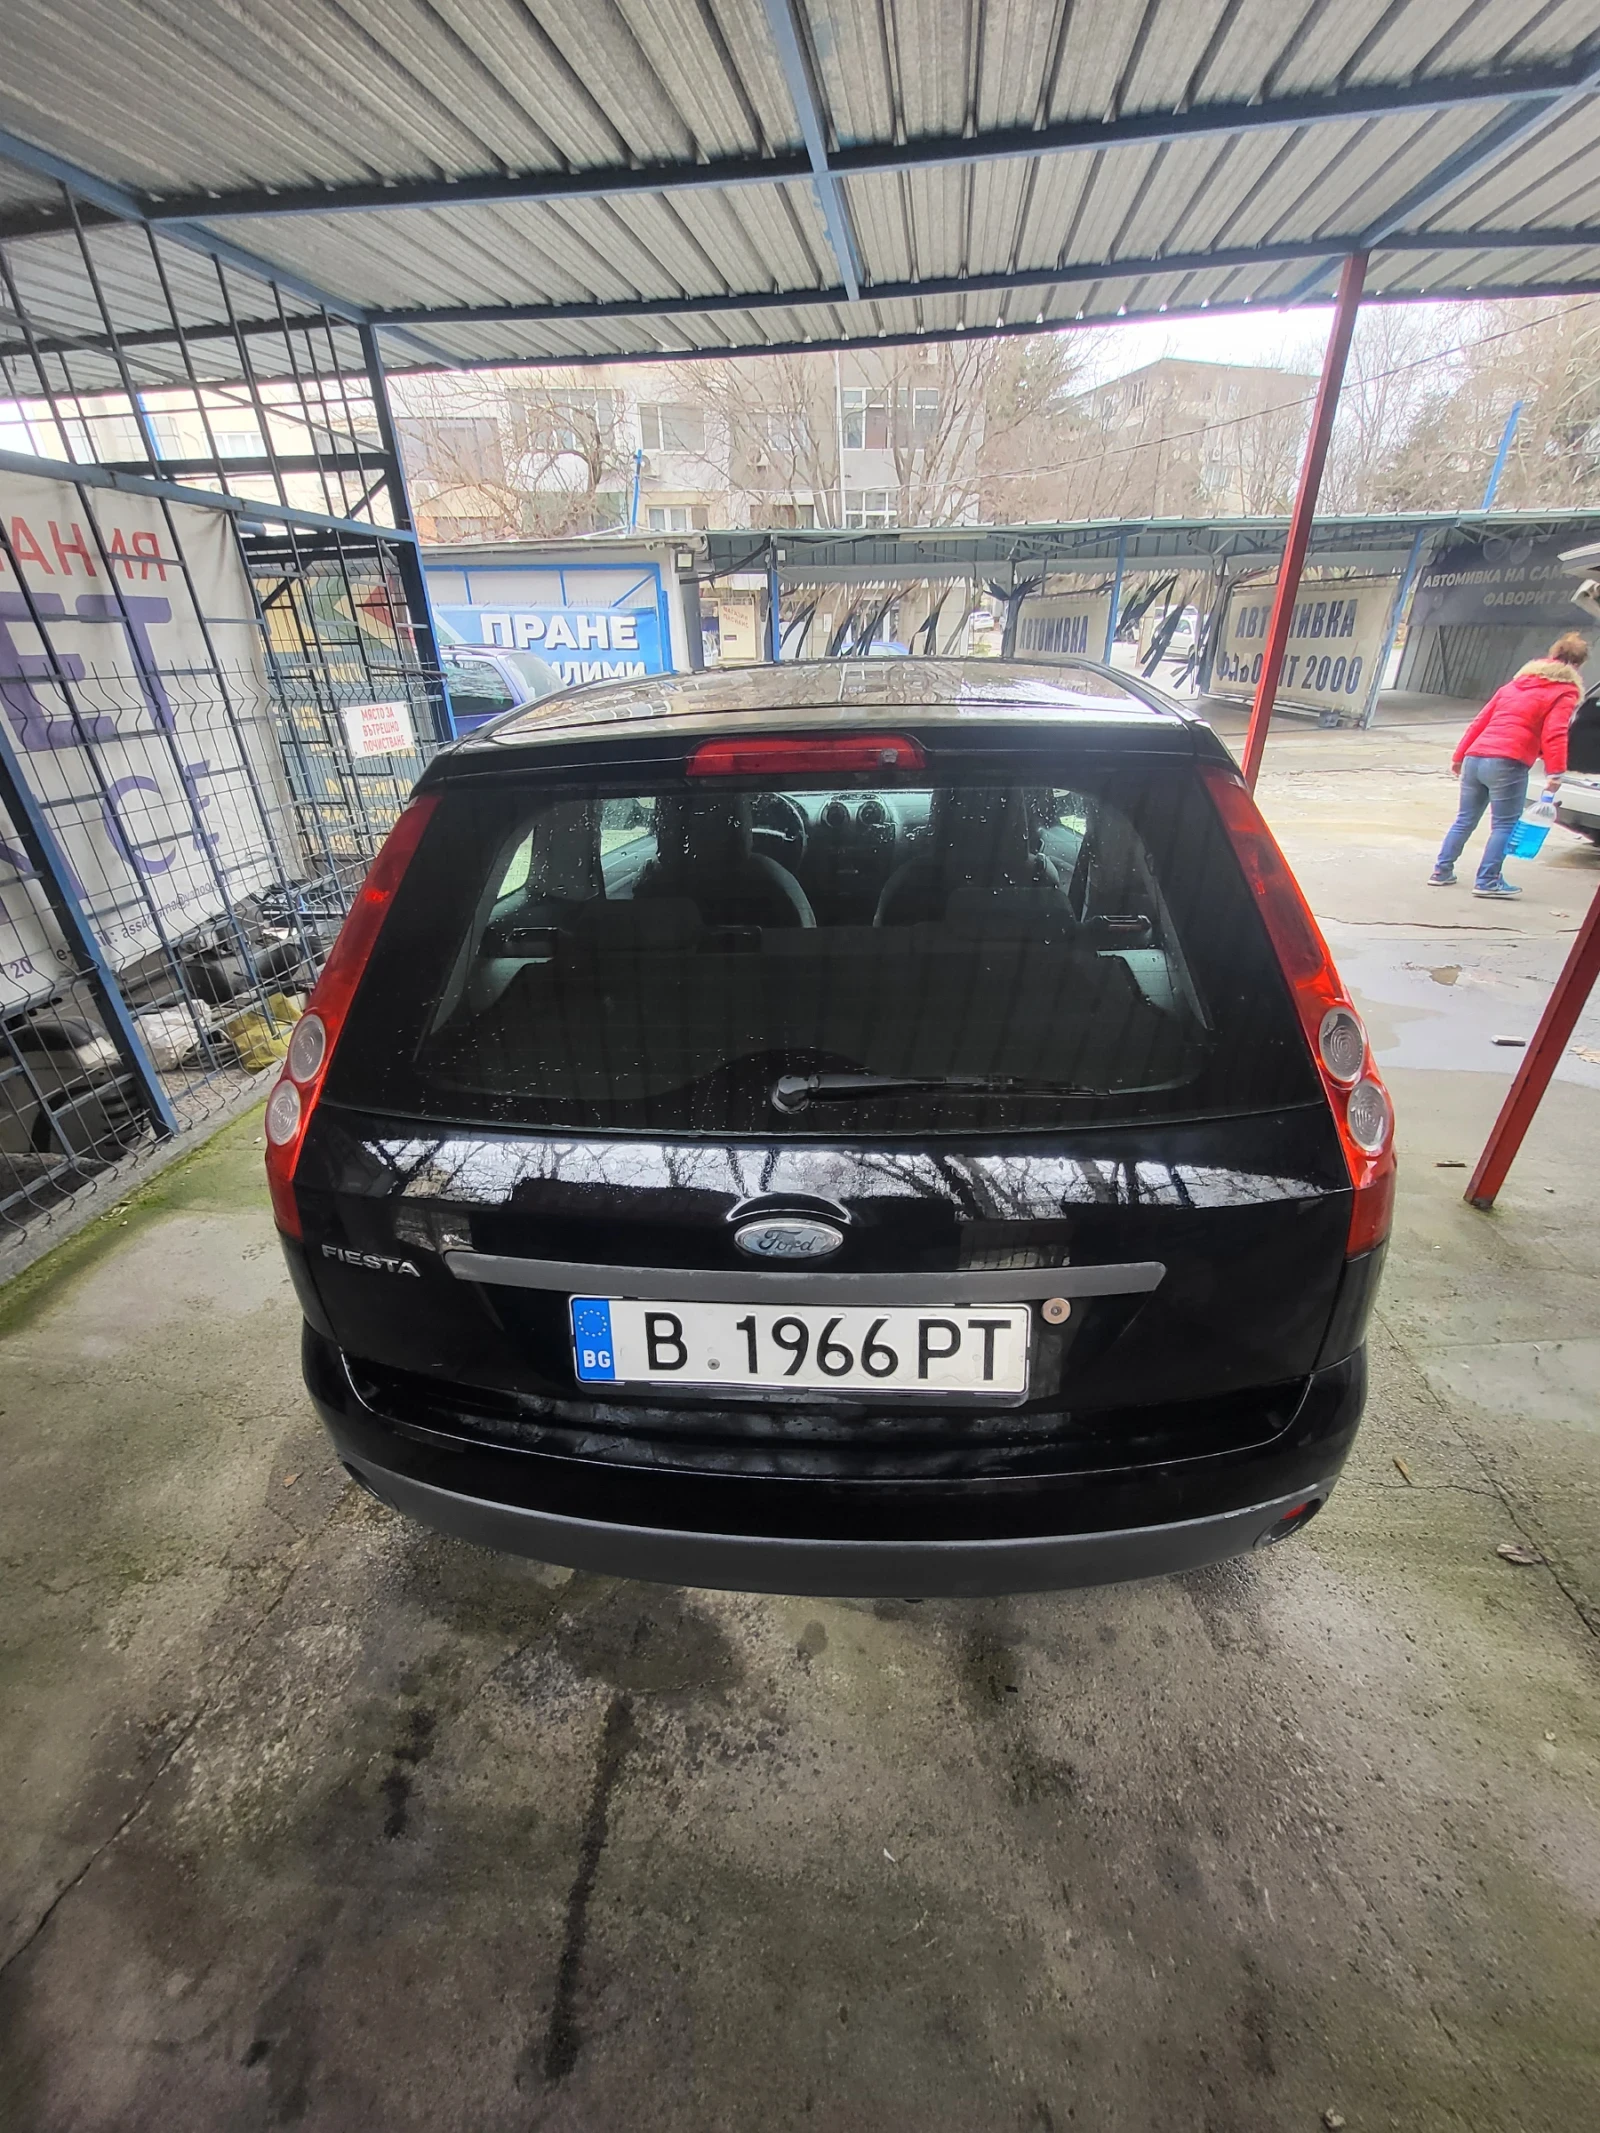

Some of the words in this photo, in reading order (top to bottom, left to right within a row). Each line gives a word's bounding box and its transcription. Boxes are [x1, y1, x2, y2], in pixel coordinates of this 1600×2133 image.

[1423, 568, 1500, 588] АВТОМИВКА
[1503, 567, 1526, 582] НА
[1529, 565, 1574, 582] САМ
[1483, 590, 1556, 607] ФАВОРИТ
[480, 613, 639, 649] ПРАНЕ
[1019, 615, 1088, 654] АВТОМИВКА
[1301, 655, 1363, 694] 2000
[361, 707, 385, 721] МЯСТО
[385, 706, 395, 719] ЗА
[362, 720, 400, 737] ВЪТРЕШНО
[363, 734, 406, 753] ПОЧИСТВАНЕ
[758, 1229, 817, 1252] Ford
[321, 1244, 421, 1278] FIESTA
[644, 1311, 688, 1371] B
[736, 1314, 899, 1377] 1966
[917, 1318, 1012, 1381] PT
[583, 1349, 611, 1369] BG
